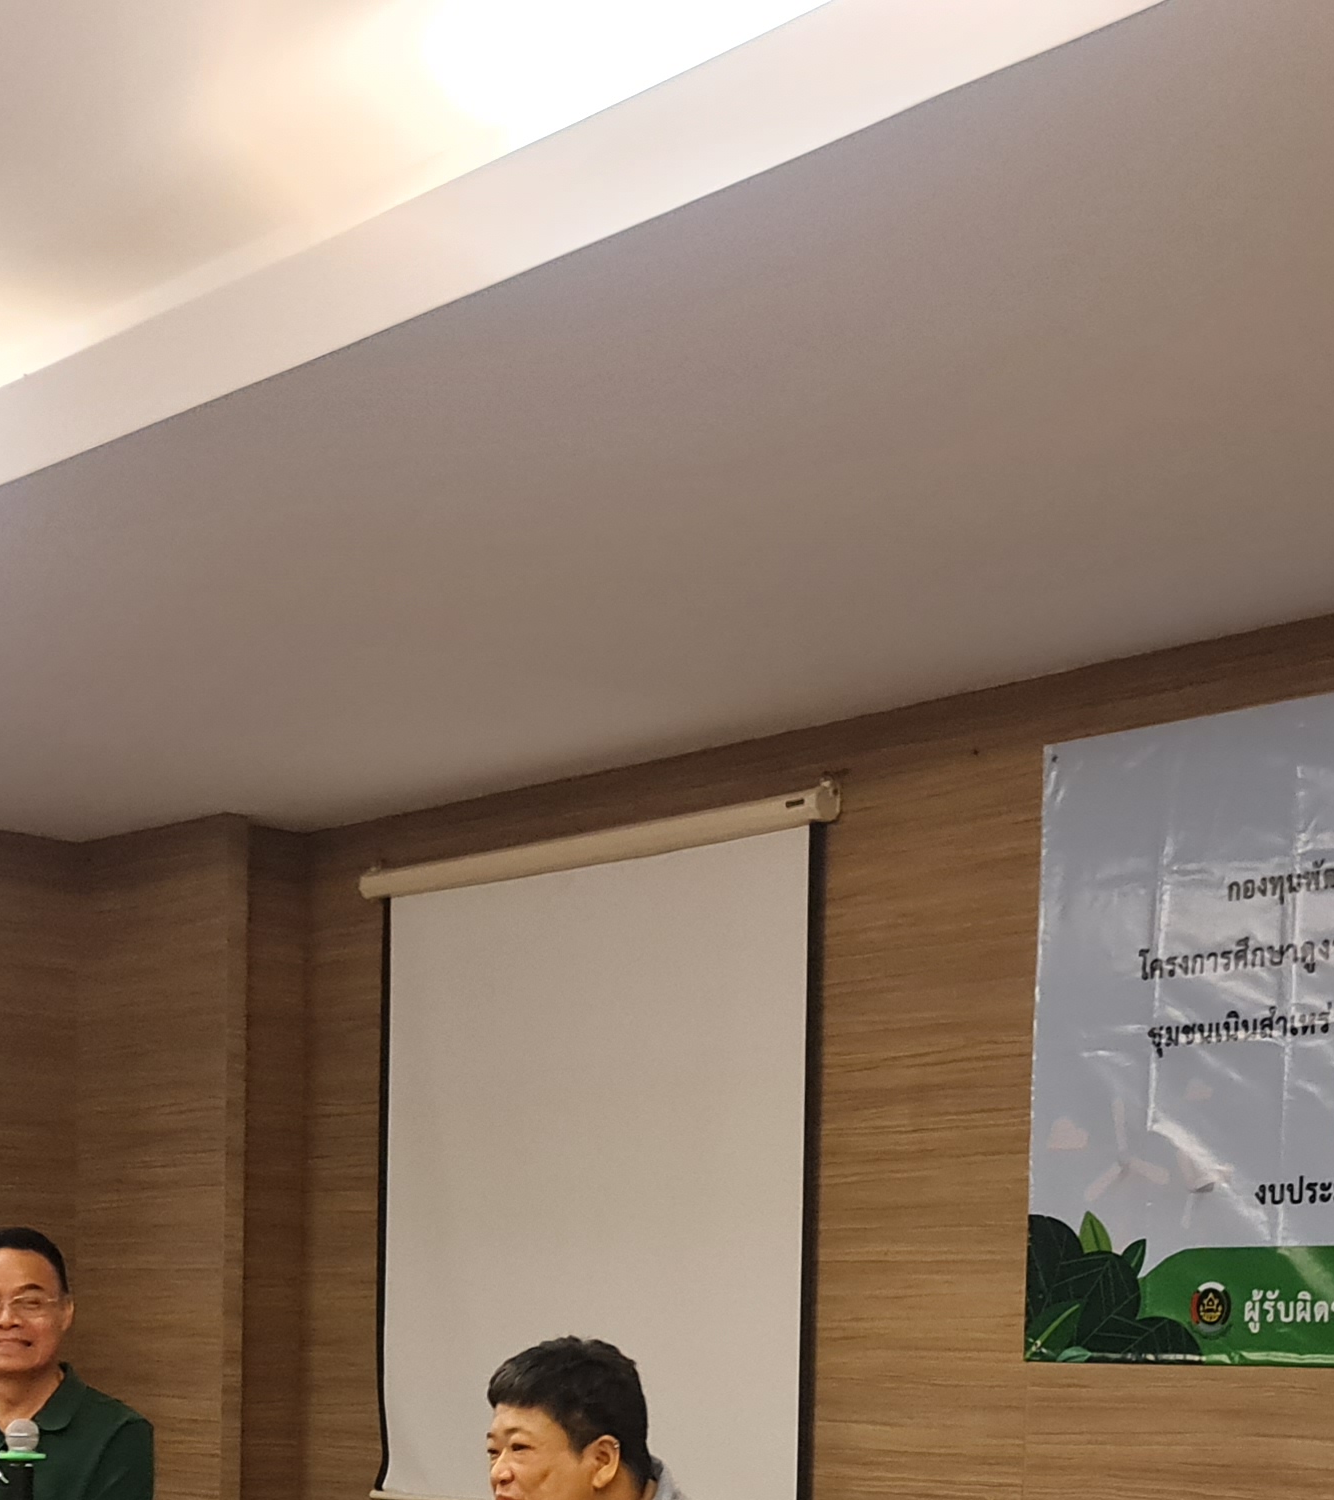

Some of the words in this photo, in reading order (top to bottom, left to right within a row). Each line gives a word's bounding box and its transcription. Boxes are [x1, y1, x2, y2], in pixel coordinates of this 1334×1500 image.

[1147, 1001, 1332, 1058] ชุมชนเนินสำเหร่
